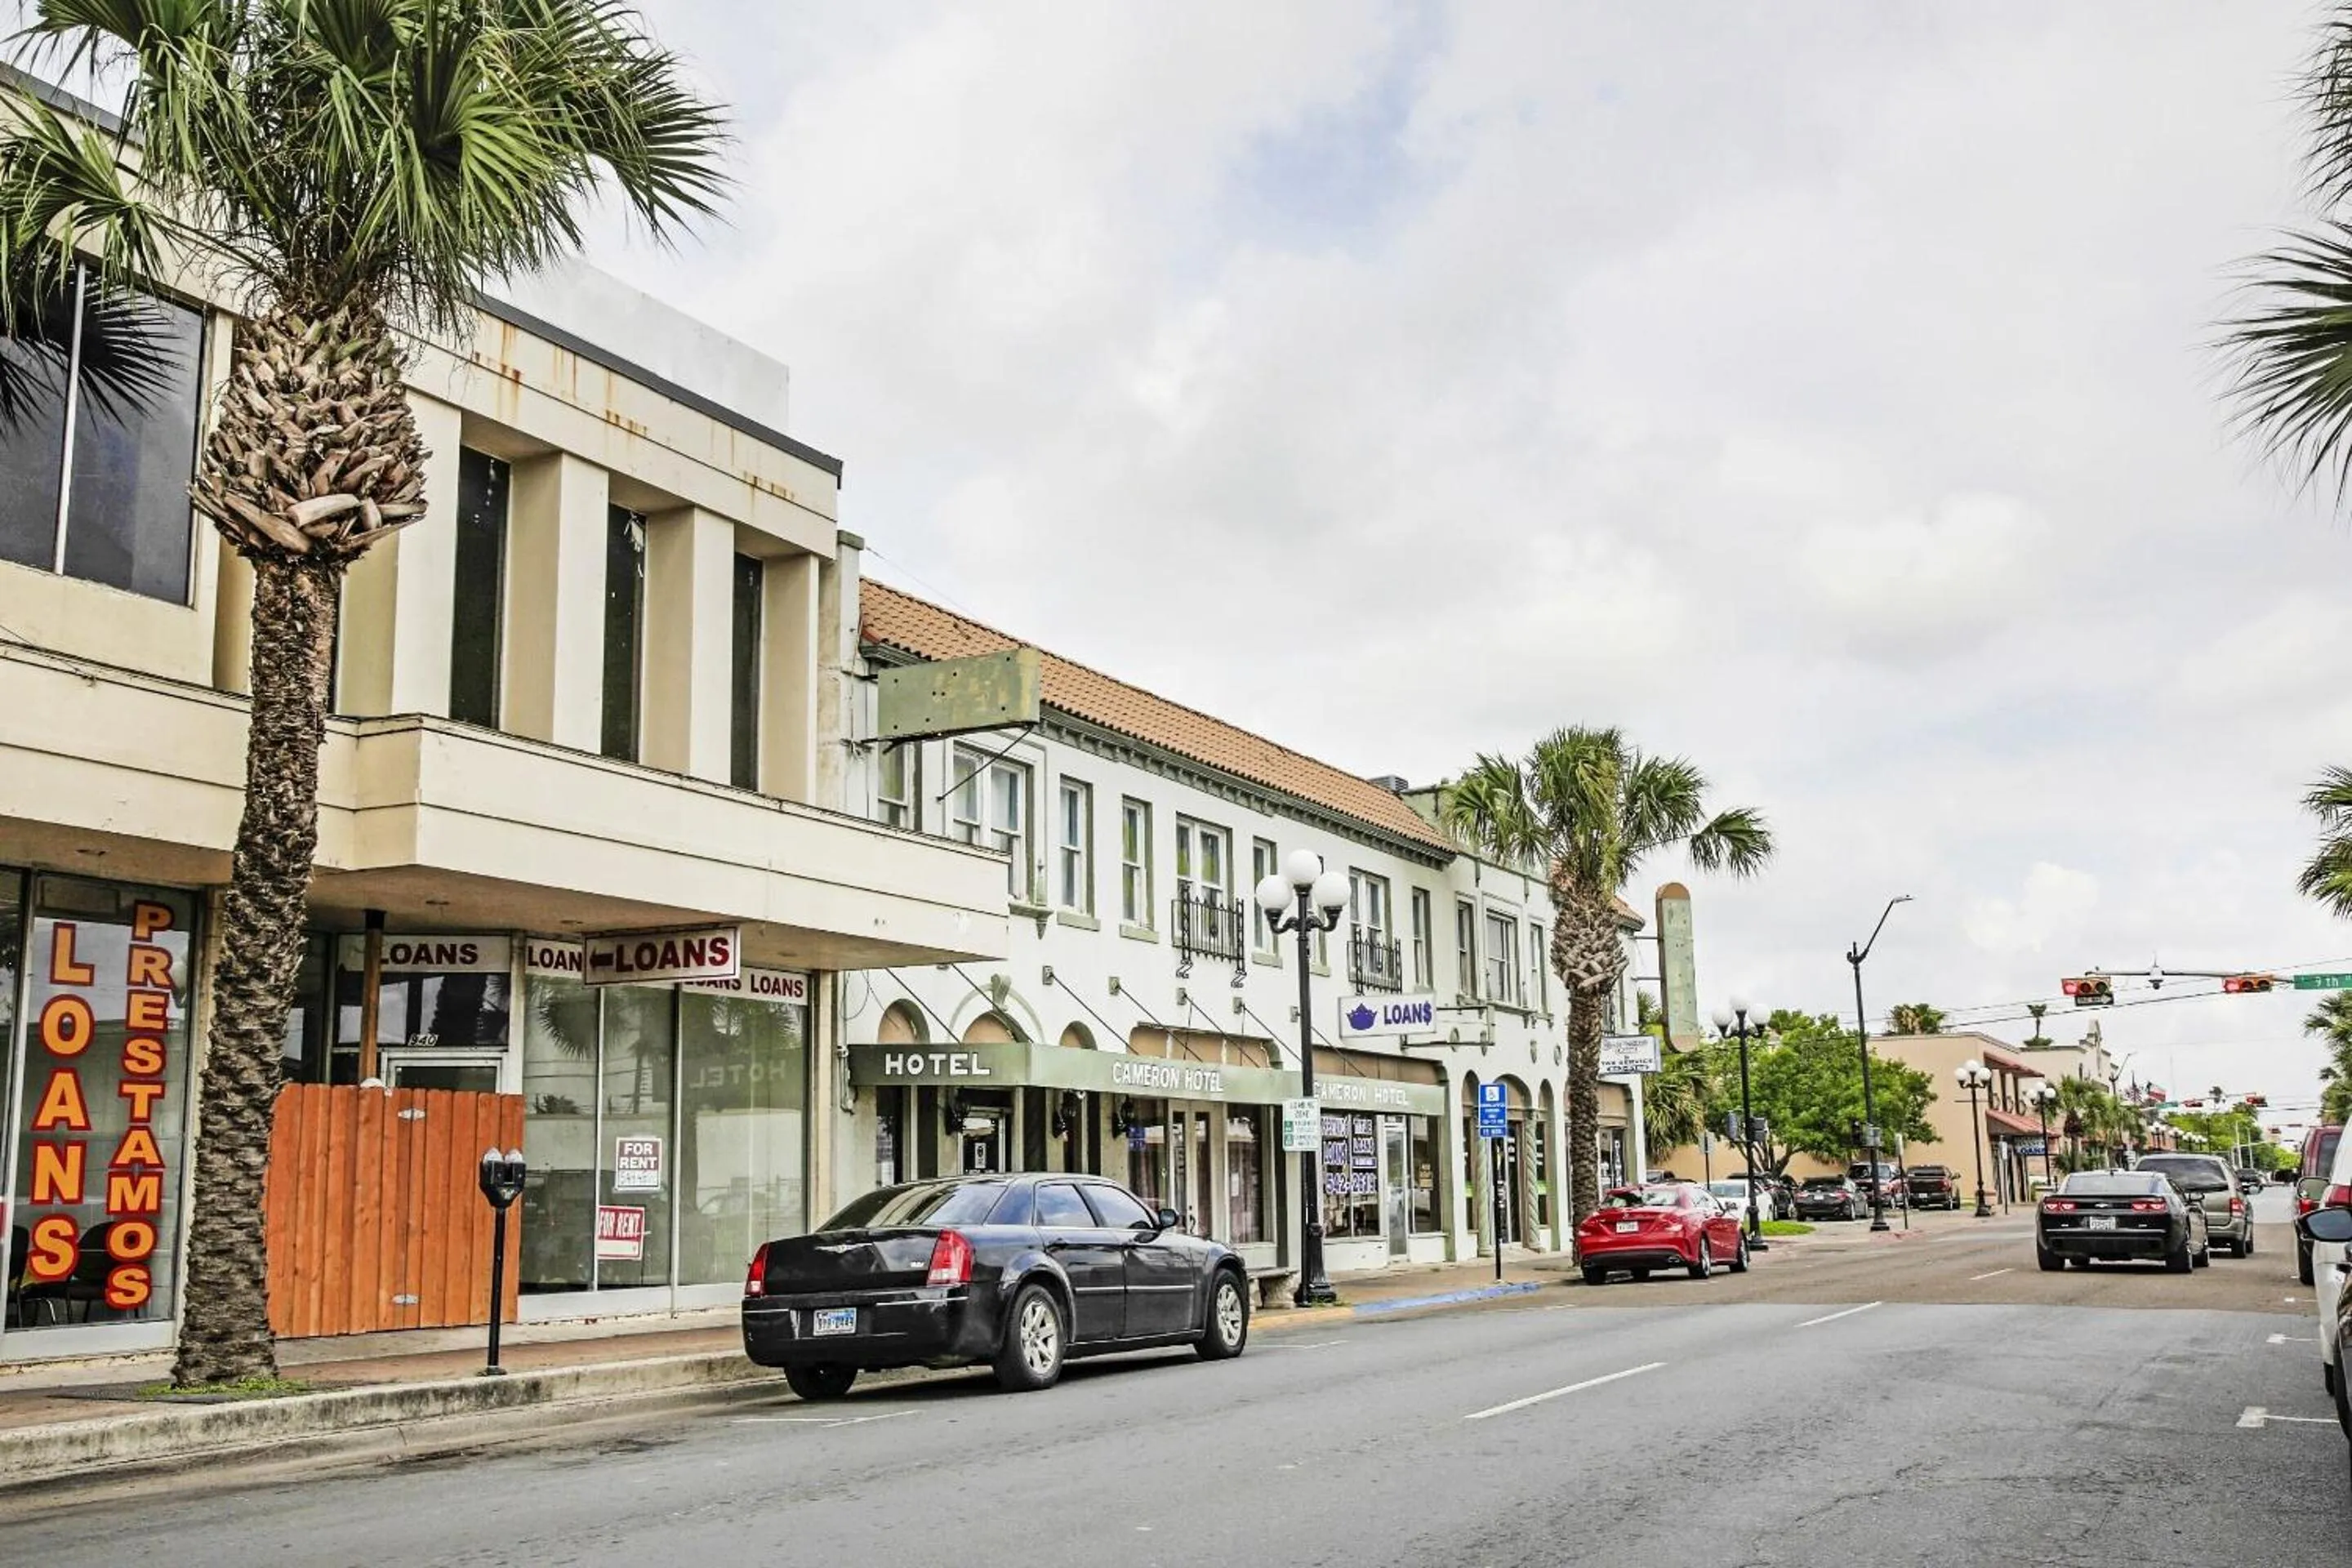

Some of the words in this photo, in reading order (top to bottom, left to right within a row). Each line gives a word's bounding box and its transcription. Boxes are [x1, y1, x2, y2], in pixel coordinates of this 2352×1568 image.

[528, 945, 582, 972] LOAN
[616, 938, 729, 973] LOANS
[751, 973, 804, 998] LOANS
[884, 1053, 991, 1076] HOTEL
[1112, 1061, 1180, 1089] CAMERON
[1185, 1068, 1224, 1093] HOTEL
[29, 922, 95, 1281] LOANS
[106, 900, 174, 1310] PRESTAMOS
[1312, 1081, 1366, 1102] CAMERON
[1374, 1087, 1410, 1106] HOTEL
[618, 1156, 658, 1169] RENT
[624, 1143, 653, 1156] FOR
[599, 1211, 615, 1237] FOR
[616, 1212, 641, 1238] RENT
